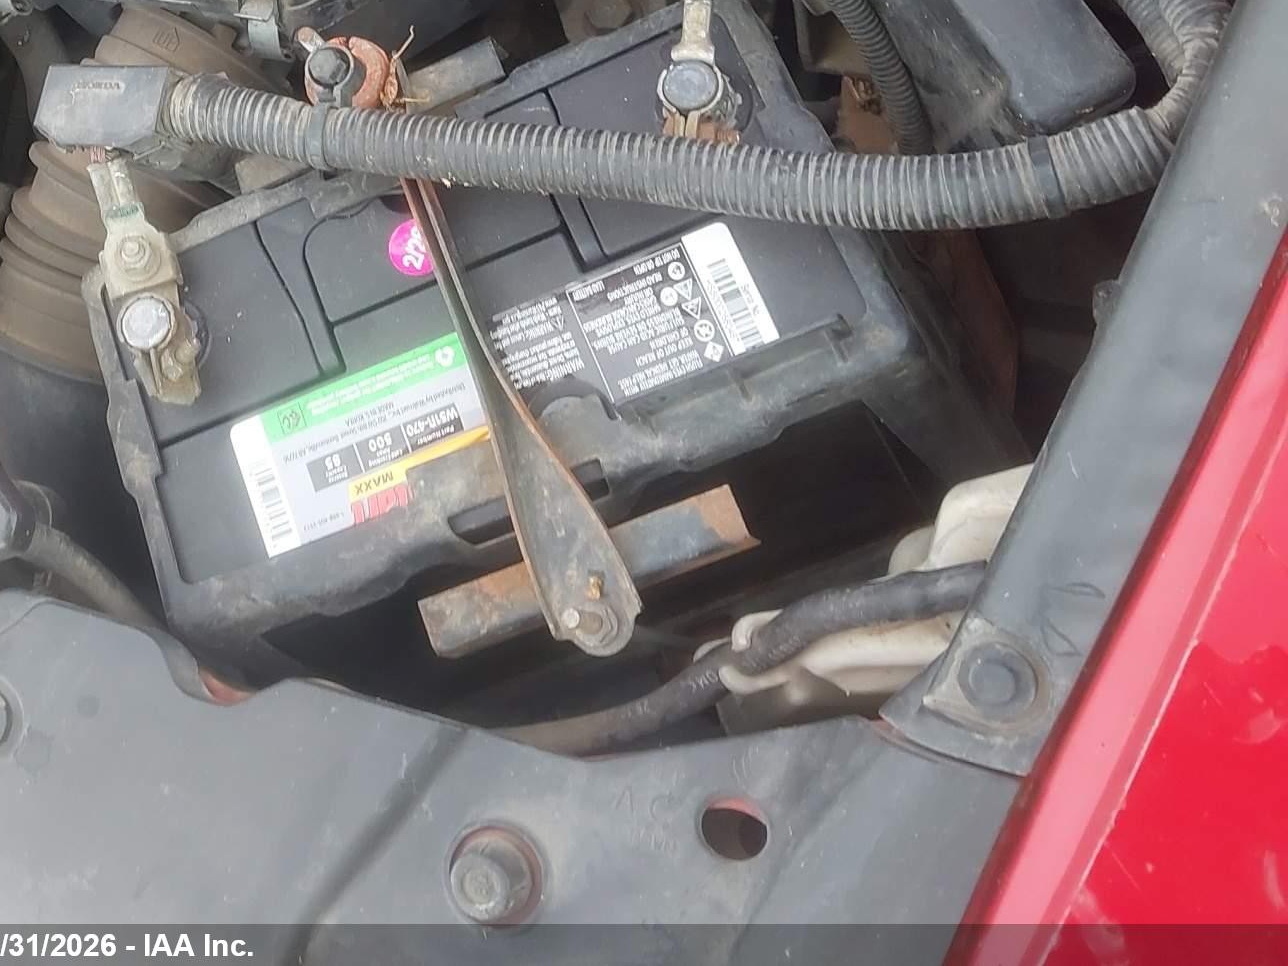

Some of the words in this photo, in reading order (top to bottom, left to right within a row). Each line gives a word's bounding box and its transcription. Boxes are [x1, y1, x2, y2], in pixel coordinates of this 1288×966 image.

[589, 280, 605, 293] LEAD
[644, 271, 663, 285] READ
[570, 285, 593, 301] BATTERY
[605, 277, 647, 302] INSTRUCTIONS
[644, 306, 681, 329] BLINDNESS
[653, 315, 685, 335] SULFURIC
[613, 324, 637, 341] SEVERE
[625, 333, 641, 347] CAN
[638, 327, 655, 341] ACID
[648, 330, 680, 350] CHILDREN
[663, 342, 678, 355] OUT
[675, 335, 693, 350] KEEP
[634, 350, 656, 367] REACH
[543, 355, 584, 382] WARNING:
[417, 429, 440, 446] Number
[441, 424, 453, 436] Part
[368, 431, 391, 452] 500
[368, 451, 390, 468] Cranking
[392, 447, 402, 458] Cold
[354, 470, 392, 496] MAXX
